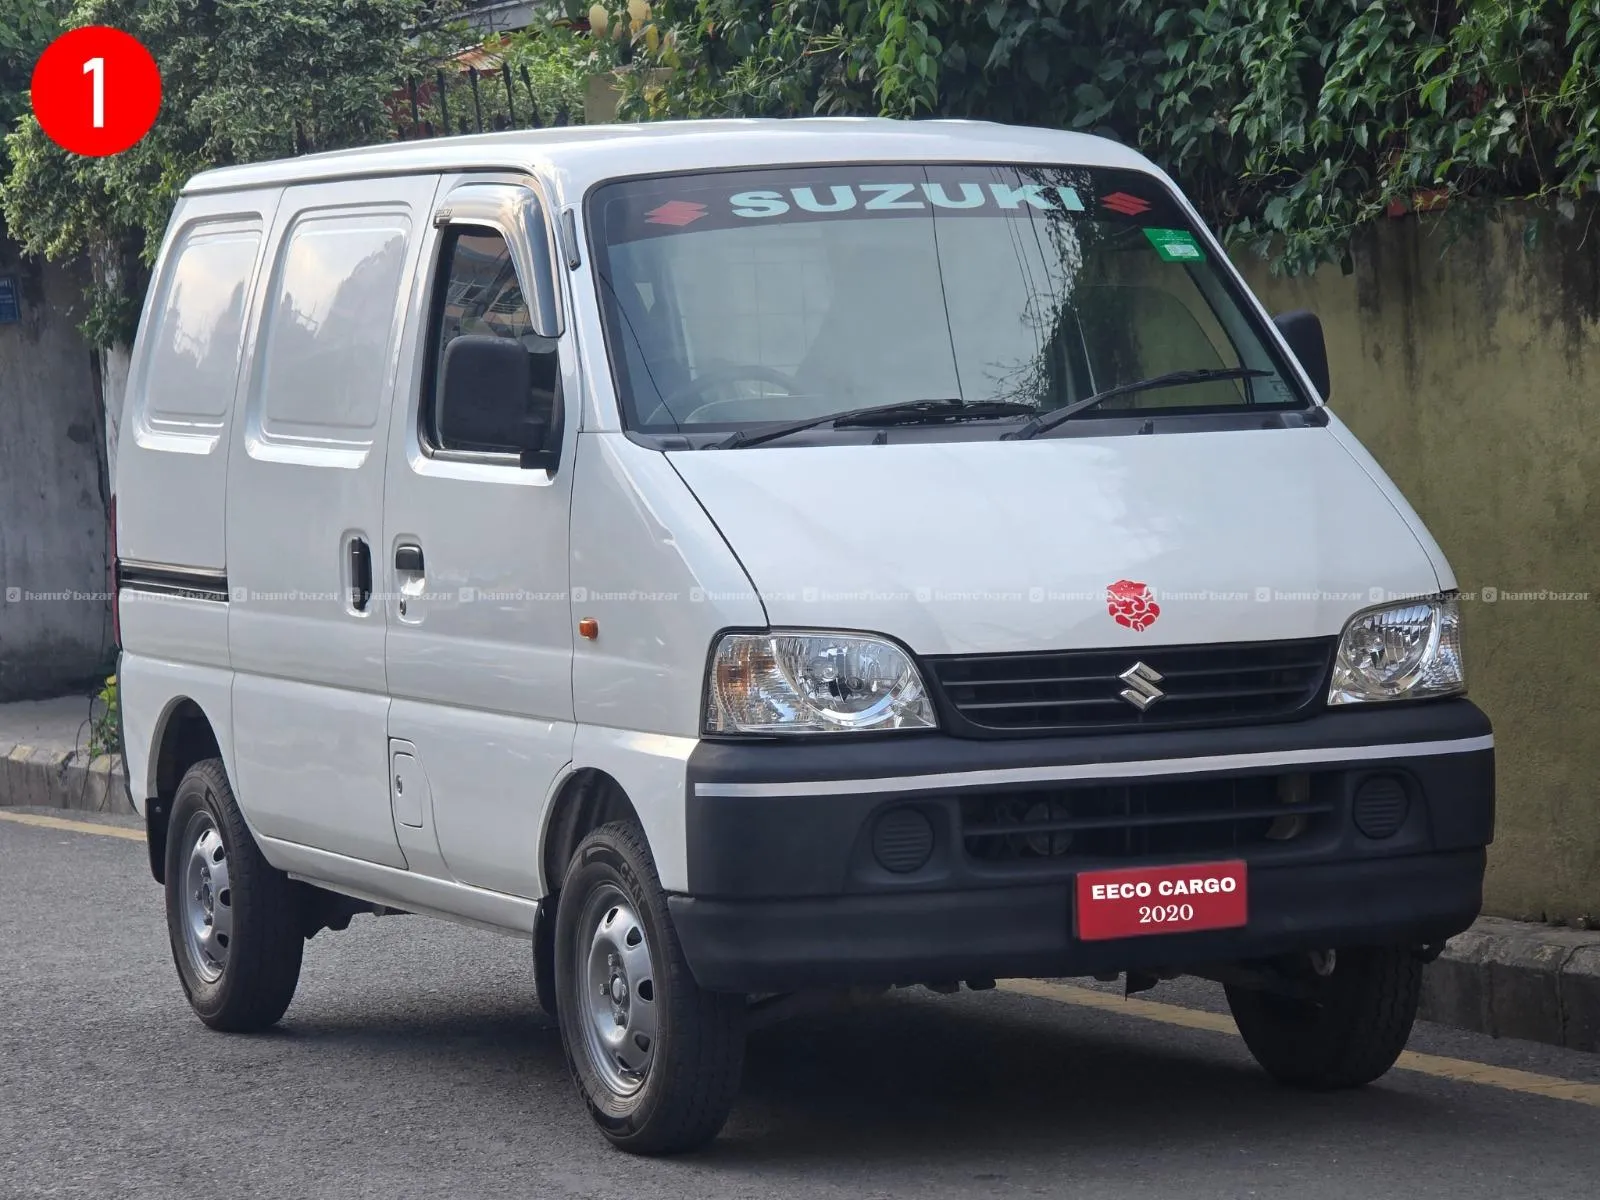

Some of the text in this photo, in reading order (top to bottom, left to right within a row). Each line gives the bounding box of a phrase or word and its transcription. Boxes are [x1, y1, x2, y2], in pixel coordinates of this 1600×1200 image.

[729, 183, 1085, 218] SUZUKI
[1091, 877, 1237, 901] EECO CARGO
[1138, 904, 1194, 923] 2020
